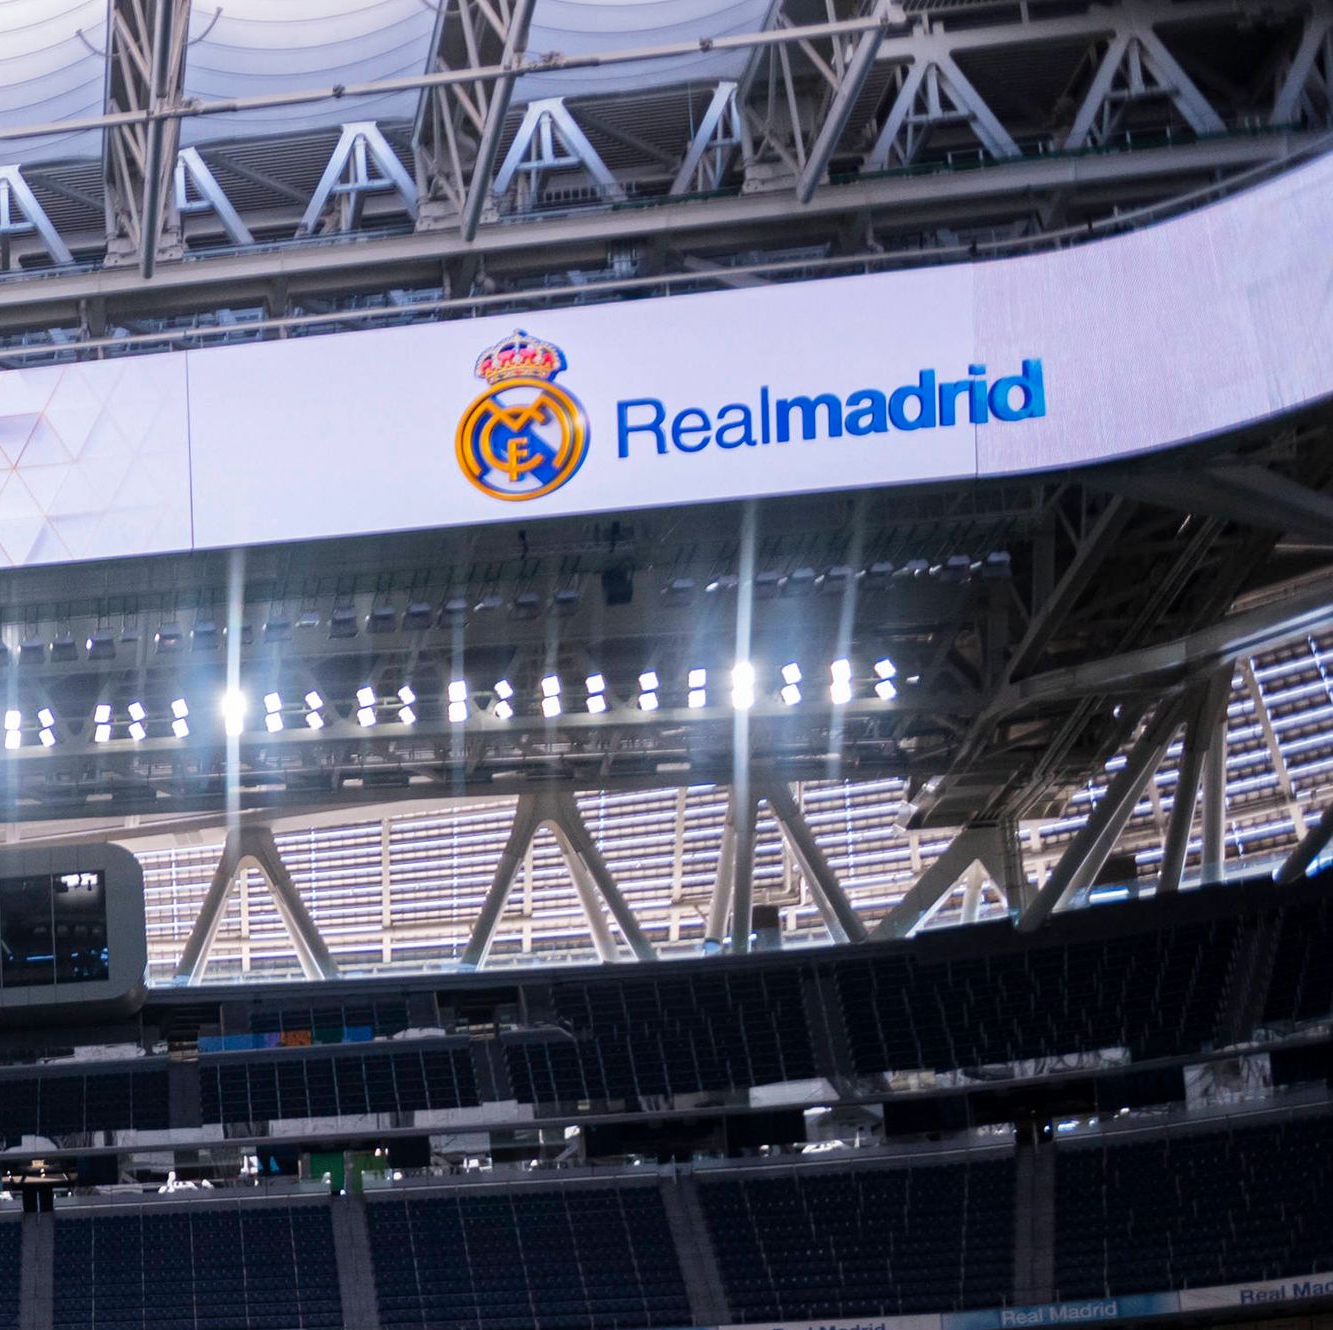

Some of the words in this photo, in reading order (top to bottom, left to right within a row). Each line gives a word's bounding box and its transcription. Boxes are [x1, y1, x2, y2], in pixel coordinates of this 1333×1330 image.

[616, 357, 1046, 459] Realmadrid
[1240, 1284, 1286, 1304] Real
[1002, 1309, 1043, 1325] Real
[1049, 1302, 1118, 1322] Madrid
